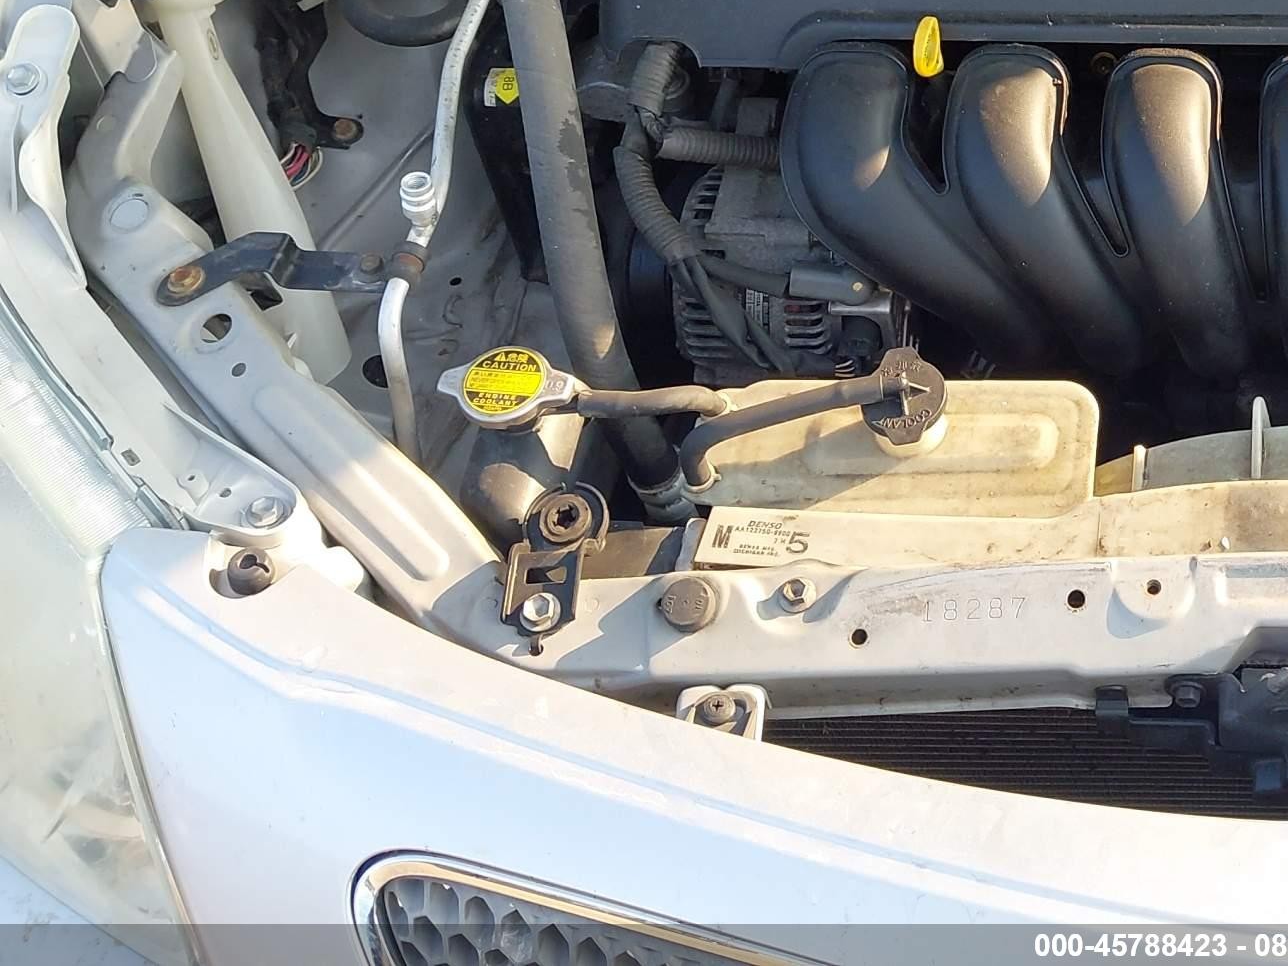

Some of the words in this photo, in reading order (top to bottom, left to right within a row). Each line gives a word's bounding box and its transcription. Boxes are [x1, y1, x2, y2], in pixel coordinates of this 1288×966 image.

[482, 360, 537, 372] CAUTION
[473, 397, 519, 407] COOLANT
[478, 392, 517, 401] ENGINE
[747, 520, 783, 530] DENSO
[711, 524, 734, 549] M
[785, 530, 811, 555] 5
[922, 596, 1026, 622] 18287
